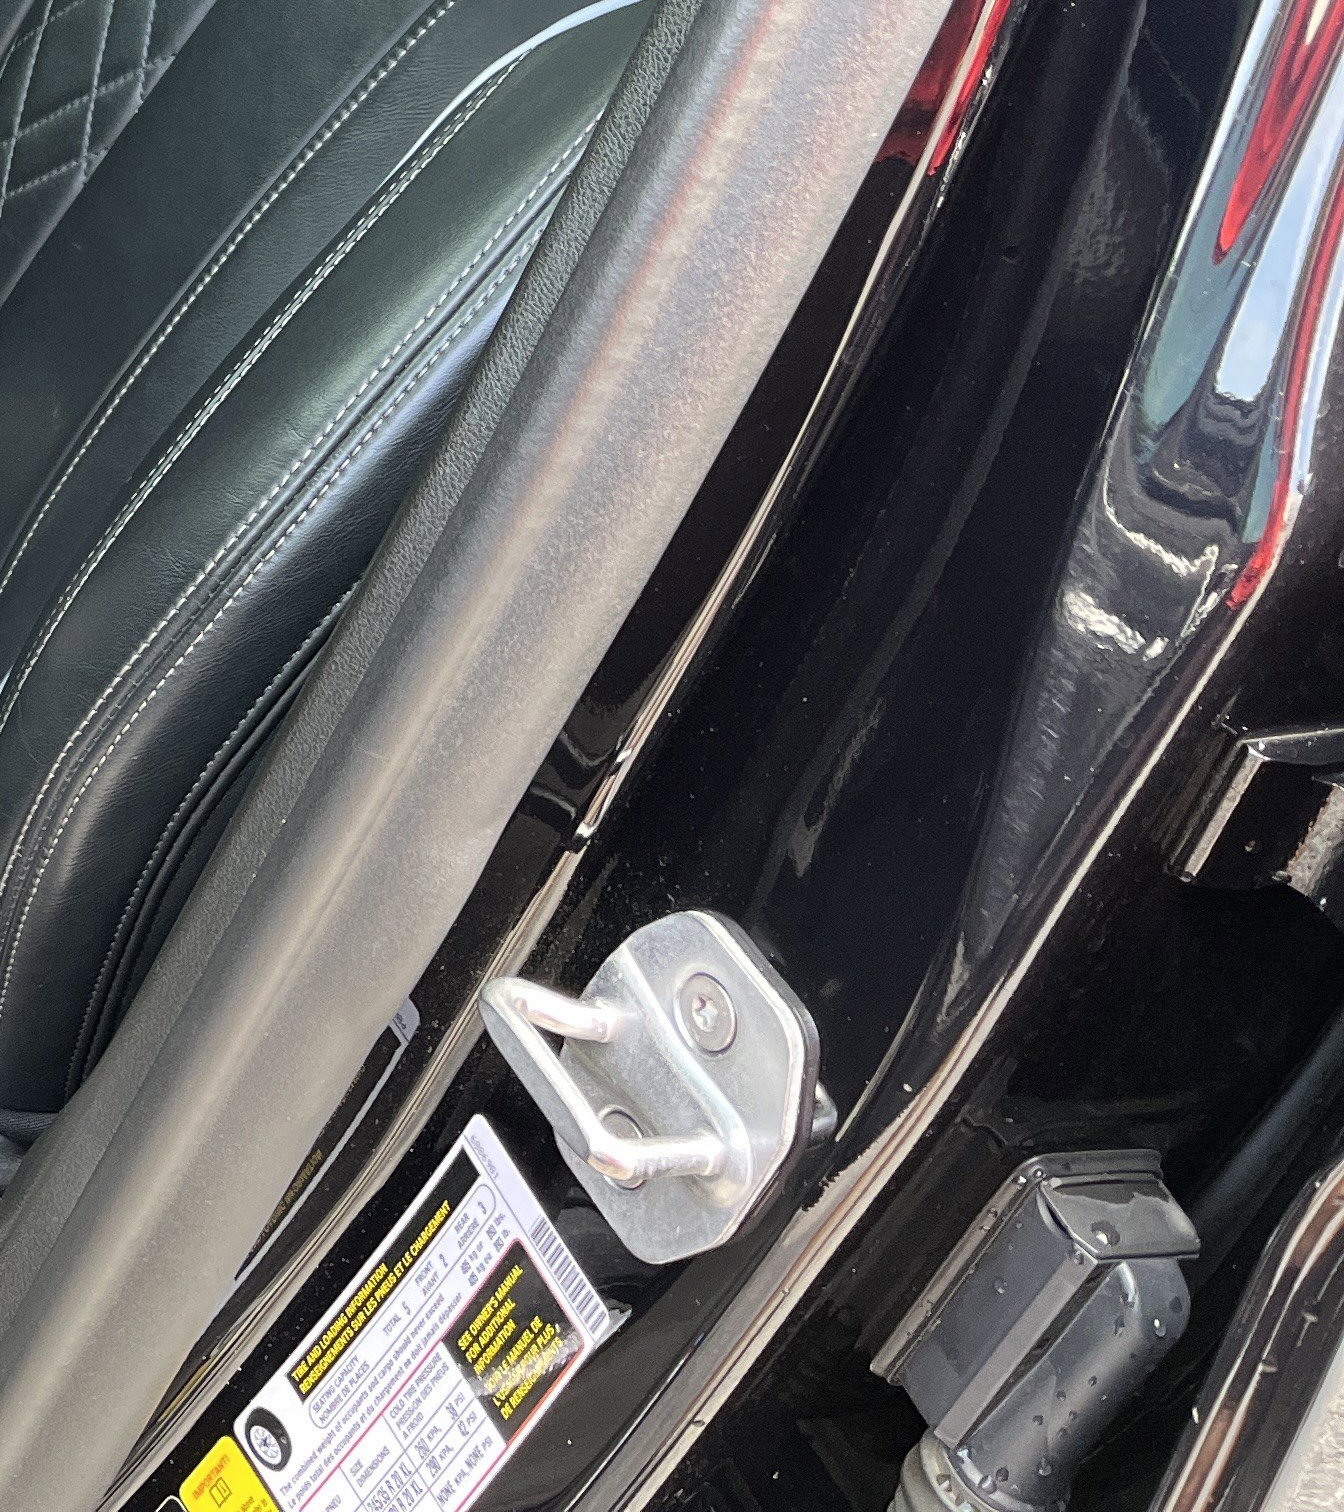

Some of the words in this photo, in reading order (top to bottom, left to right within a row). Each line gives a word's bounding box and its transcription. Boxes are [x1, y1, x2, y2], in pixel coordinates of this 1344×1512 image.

[454, 1213, 469, 1234] REAR
[415, 1261, 433, 1286] FRONT
[439, 1253, 448, 1267] 2
[299, 1327, 353, 1393] RENSEIGNEMENTS
[351, 1311, 366, 1331] SUR
[363, 1297, 377, 1316] LES
[374, 1273, 396, 1301] PNEUS
[393, 1261, 404, 1278] ET
[402, 1251, 412, 1267] LE
[410, 1200, 449, 1255] CHARGEMENT
[422, 1271, 439, 1296] AVANT
[291, 1360, 309, 1381] TIRE
[306, 1345, 321, 1366] AND
[319, 1313, 347, 1349] LOADING
[345, 1263, 387, 1317] INFORMATION
[383, 1314, 401, 1335] TOTAL
[402, 1301, 410, 1315] 5
[458, 1330, 472, 1350] SEE
[469, 1297, 498, 1335] OWNER'S
[495, 1265, 522, 1301] MANUAL
[466, 1342, 481, 1363] FOR
[479, 1299, 515, 1347] ADDITIONAL
[474, 1319, 515, 1375] INFORMATION
[498, 1360, 511, 1375] LE
[506, 1329, 534, 1366] MANUEL
[530, 1316, 542, 1333] DE
[536, 1323, 554, 1349] PLUS
[279, 1482, 292, 1496] The
[292, 1451, 317, 1483] combined
[316, 1430, 336, 1453] weight
[342, 1391, 368, 1424] occupants
[368, 1376, 379, 1392] and
[378, 1359, 393, 1379] cargo
[410, 1318, 425, 1338] never
[425, 1293, 444, 1320] exceed
[288, 1498, 296, 1509] Le
[295, 1481, 311, 1501] poids
[310, 1464, 324, 1482] total
[323, 1453, 334, 1467] des
[334, 1421, 360, 1455] occupants
[374, 1366, 404, 1406] chargement
[421, 1323, 439, 1348] jamais
[438, 1292, 461, 1324] dépasser
[312, 1385, 335, 1413] SEATING
[334, 1355, 358, 1387] CAPACITY
[319, 1394, 343, 1423] NOMBRE
[341, 1384, 350, 1397] DE
[349, 1361, 369, 1387] PLACES
[390, 1399, 405, 1418] COLD
[403, 1384, 417, 1400] TIRE
[415, 1352, 441, 1386] PRESSURE
[396, 1397, 422, 1430] PRESSION
[420, 1383, 432, 1399] DES
[430, 1362, 449, 1386] PNEUS
[454, 1392, 465, 1407] PSI
[406, 1412, 423, 1433] FROID
[466, 1411, 477, 1426] PSI
[500, 1402, 513, 1420] DE
[192, 1455, 229, 1499] IMPORTANT!
[350, 1459, 363, 1476] SIZE
[357, 1446, 389, 1487] DIMENSIONS
[399, 1461, 411, 1478] XL
[437, 1480, 455, 1505] NONE
[465, 1445, 483, 1469] NONE
[481, 1436, 492, 1451] PSI
